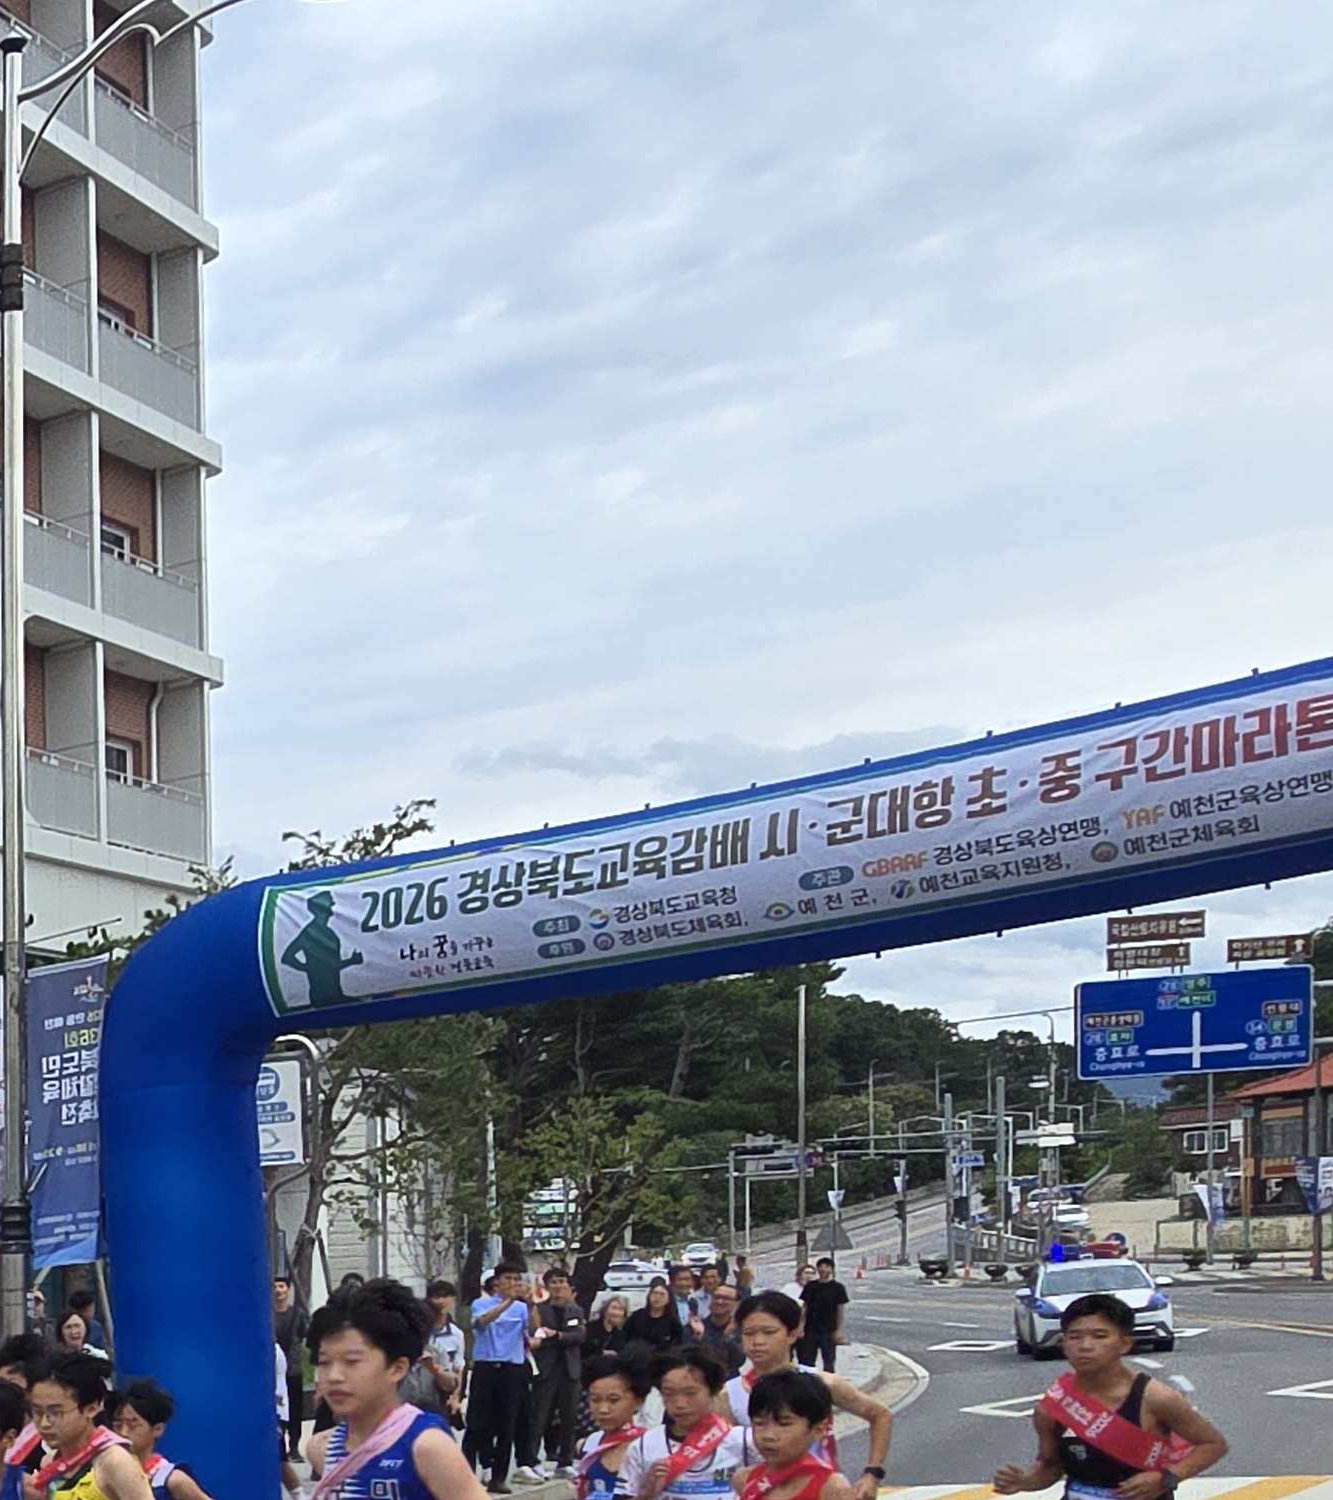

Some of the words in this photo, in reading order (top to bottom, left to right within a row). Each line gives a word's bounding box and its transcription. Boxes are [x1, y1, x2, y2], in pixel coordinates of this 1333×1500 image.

[1121, 803, 1165, 830] YAF
[1123, 813, 1260, 858] 예천군체육회
[361, 877, 450, 933] 2026
[457, 817, 752, 915] 경상북도교육감배
[614, 885, 738, 925] 경상북도교육청
